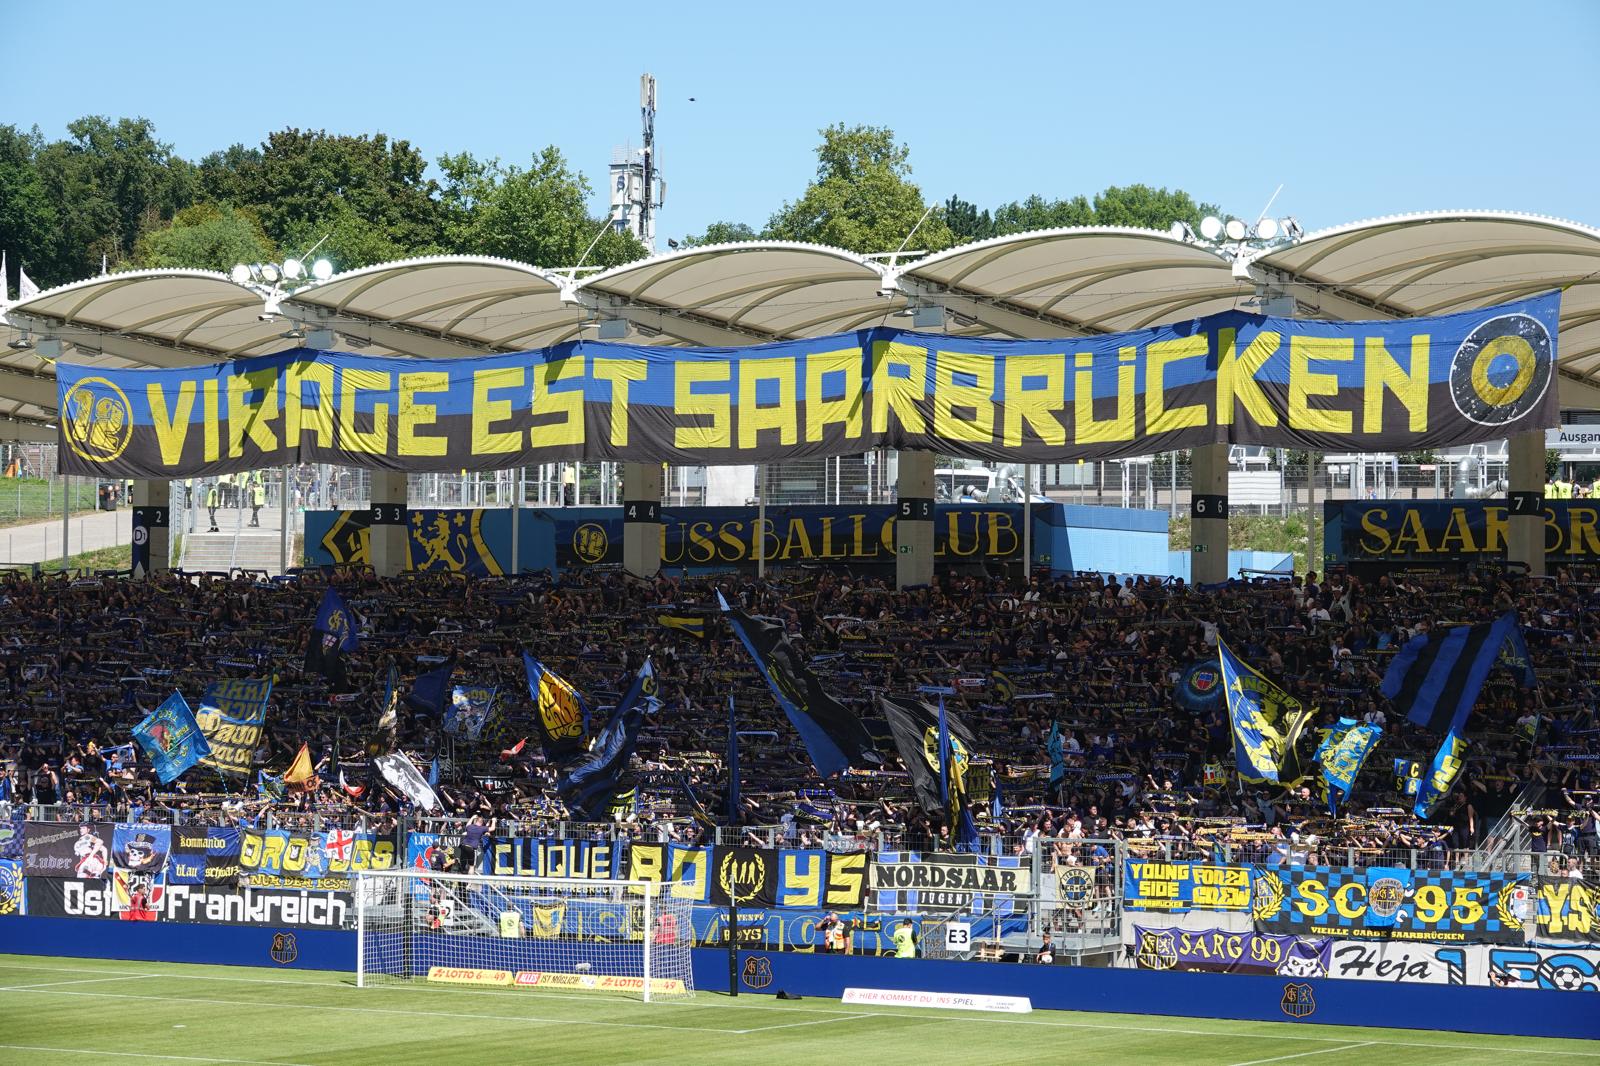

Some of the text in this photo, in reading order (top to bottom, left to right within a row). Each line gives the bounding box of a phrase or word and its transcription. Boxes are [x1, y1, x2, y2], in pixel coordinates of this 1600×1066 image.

[146, 363, 449, 465] VIRAGE
[471, 355, 647, 454] EST
[674, 327, 1431, 449] SAARBRÜCKEN
[902, 502, 911, 515] 5
[922, 503, 929, 516] 5
[1196, 499, 1206, 513] 6
[1217, 500, 1223, 514] 6
[1514, 497, 1524, 510] 7
[155, 510, 162, 523] 2
[374, 507, 382, 521] 3
[394, 507, 400, 521] 3
[629, 505, 637, 518] 4
[648, 505, 655, 518] 4
[494, 843, 610, 879] CLIQUE
[876, 865, 1017, 892] NORDSAAR
[1131, 863, 1189, 880] YOUNG
[1192, 868, 1249, 887] FORZA
[1139, 880, 1179, 898] SIDE
[167, 884, 346, 926] Frankreich
[1413, 884, 1485, 924] 95
[949, 929, 968, 944] E3
[1310, 926, 1465, 941] VIEILLE GARDE SAARBRÜCKEN
[1179, 929, 1281, 963] SARG 99
[1334, 945, 1432, 980] Heja
[445, 969, 475, 979] LOTTO
[518, 972, 581, 987] ALLES IST MÖGLICH!
[614, 978, 644, 989] LOTTO
[859, 992, 977, 1006] HIER KOMMST DU INS SPIEL.
